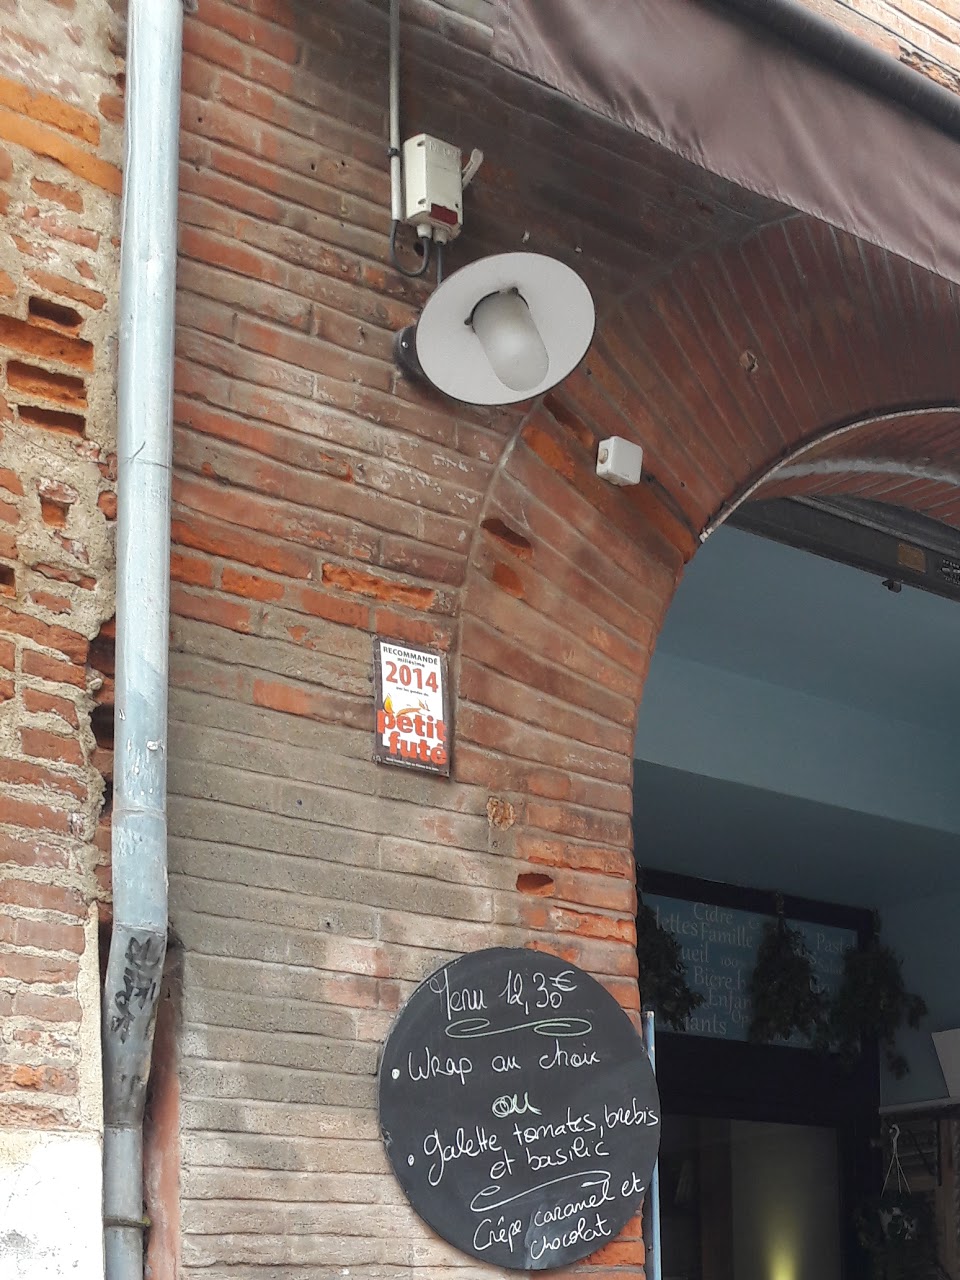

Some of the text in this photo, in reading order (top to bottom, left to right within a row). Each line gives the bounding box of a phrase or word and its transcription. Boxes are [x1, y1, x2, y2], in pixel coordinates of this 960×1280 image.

[385, 660, 439, 693] 2014
[377, 709, 448, 742] petit
[388, 731, 448, 766] futé
[656, 906, 753, 949] lettes Famille
[693, 902, 734, 925] Cidre
[428, 968, 488, 1021] Menu
[491, 1055, 521, 1074] au
[538, 1038, 601, 1071] choix
[491, 1091, 543, 1119] ou
[603, 1096, 660, 1130] brebis
[489, 1136, 611, 1180] et basilic
[472, 1175, 646, 1253] Crêpe caramel et
[529, 1213, 612, 1261] chocolat
